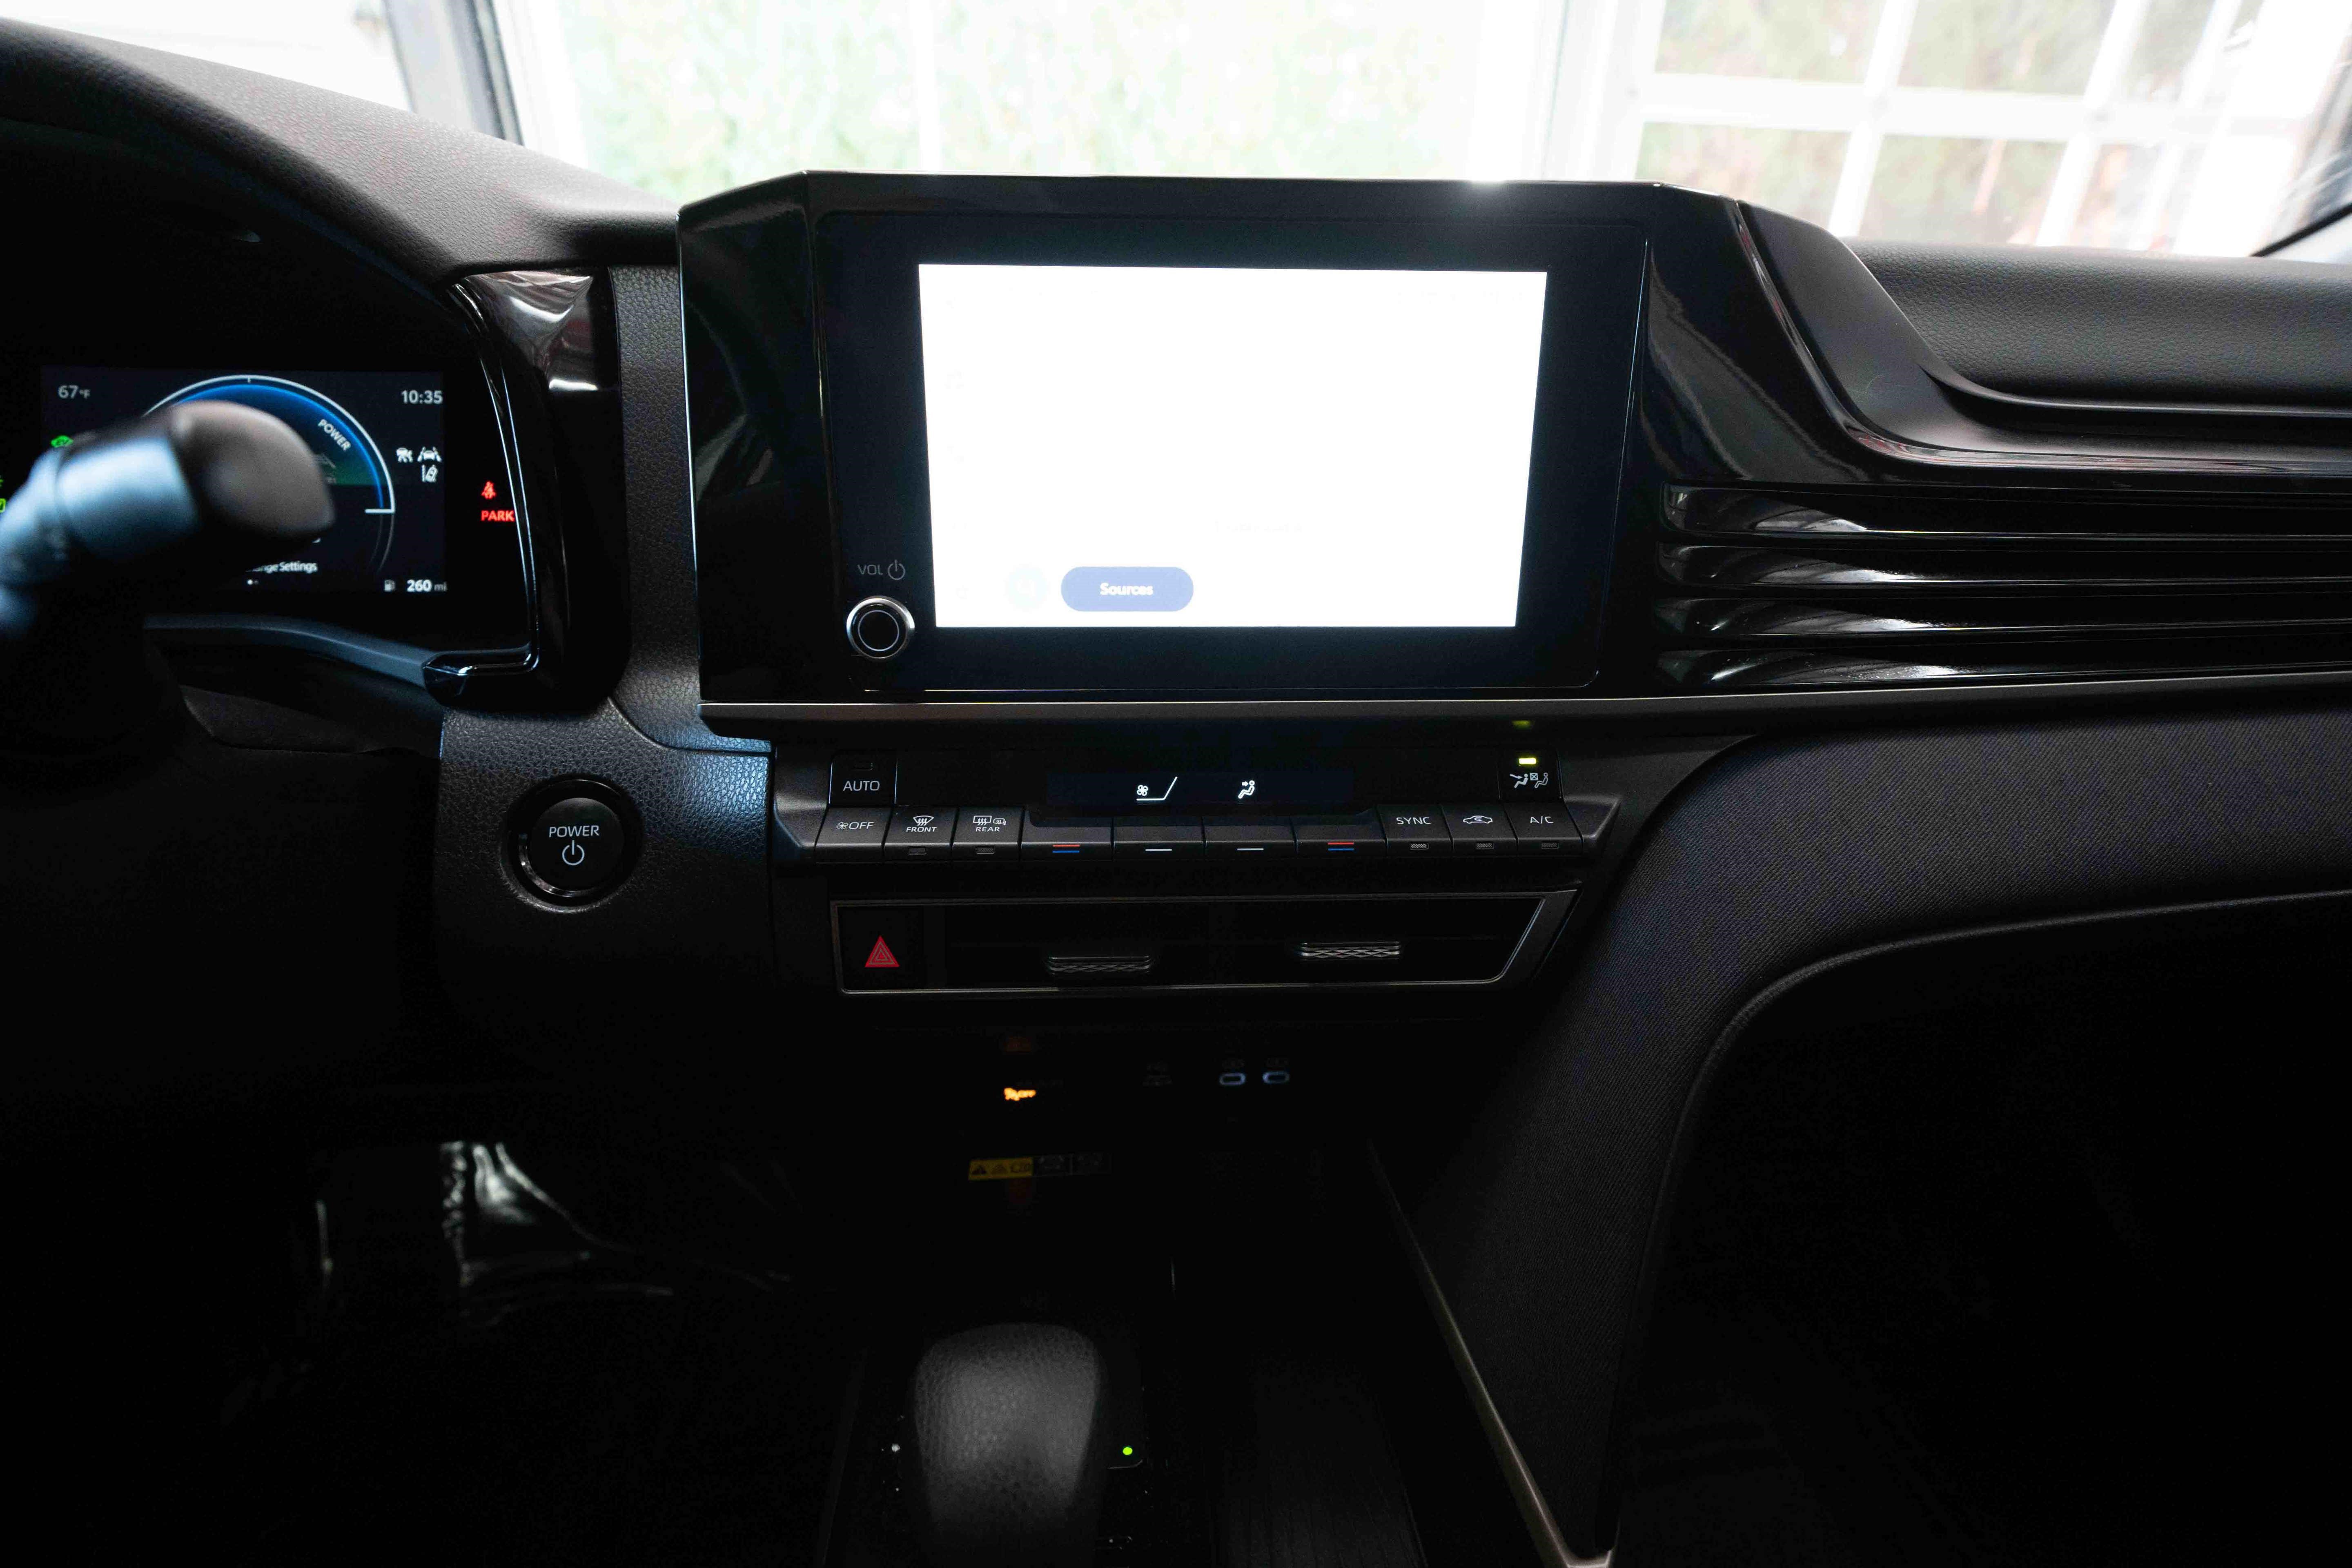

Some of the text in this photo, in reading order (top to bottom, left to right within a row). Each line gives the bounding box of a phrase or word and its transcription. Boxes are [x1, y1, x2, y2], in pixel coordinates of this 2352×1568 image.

[401, 390, 443, 404] 10:35
[318, 419, 351, 451] POWER
[481, 510, 514, 521] PARK
[279, 561, 318, 574] Settings
[858, 564, 883, 575] VOL
[407, 579, 447, 592] 260 mi
[1100, 582, 1154, 596] Sources
[843, 780, 880, 791] AUTO
[849, 822, 874, 830] OFF
[1396, 817, 1432, 825] SYNC
[549, 825, 599, 838] POWER
